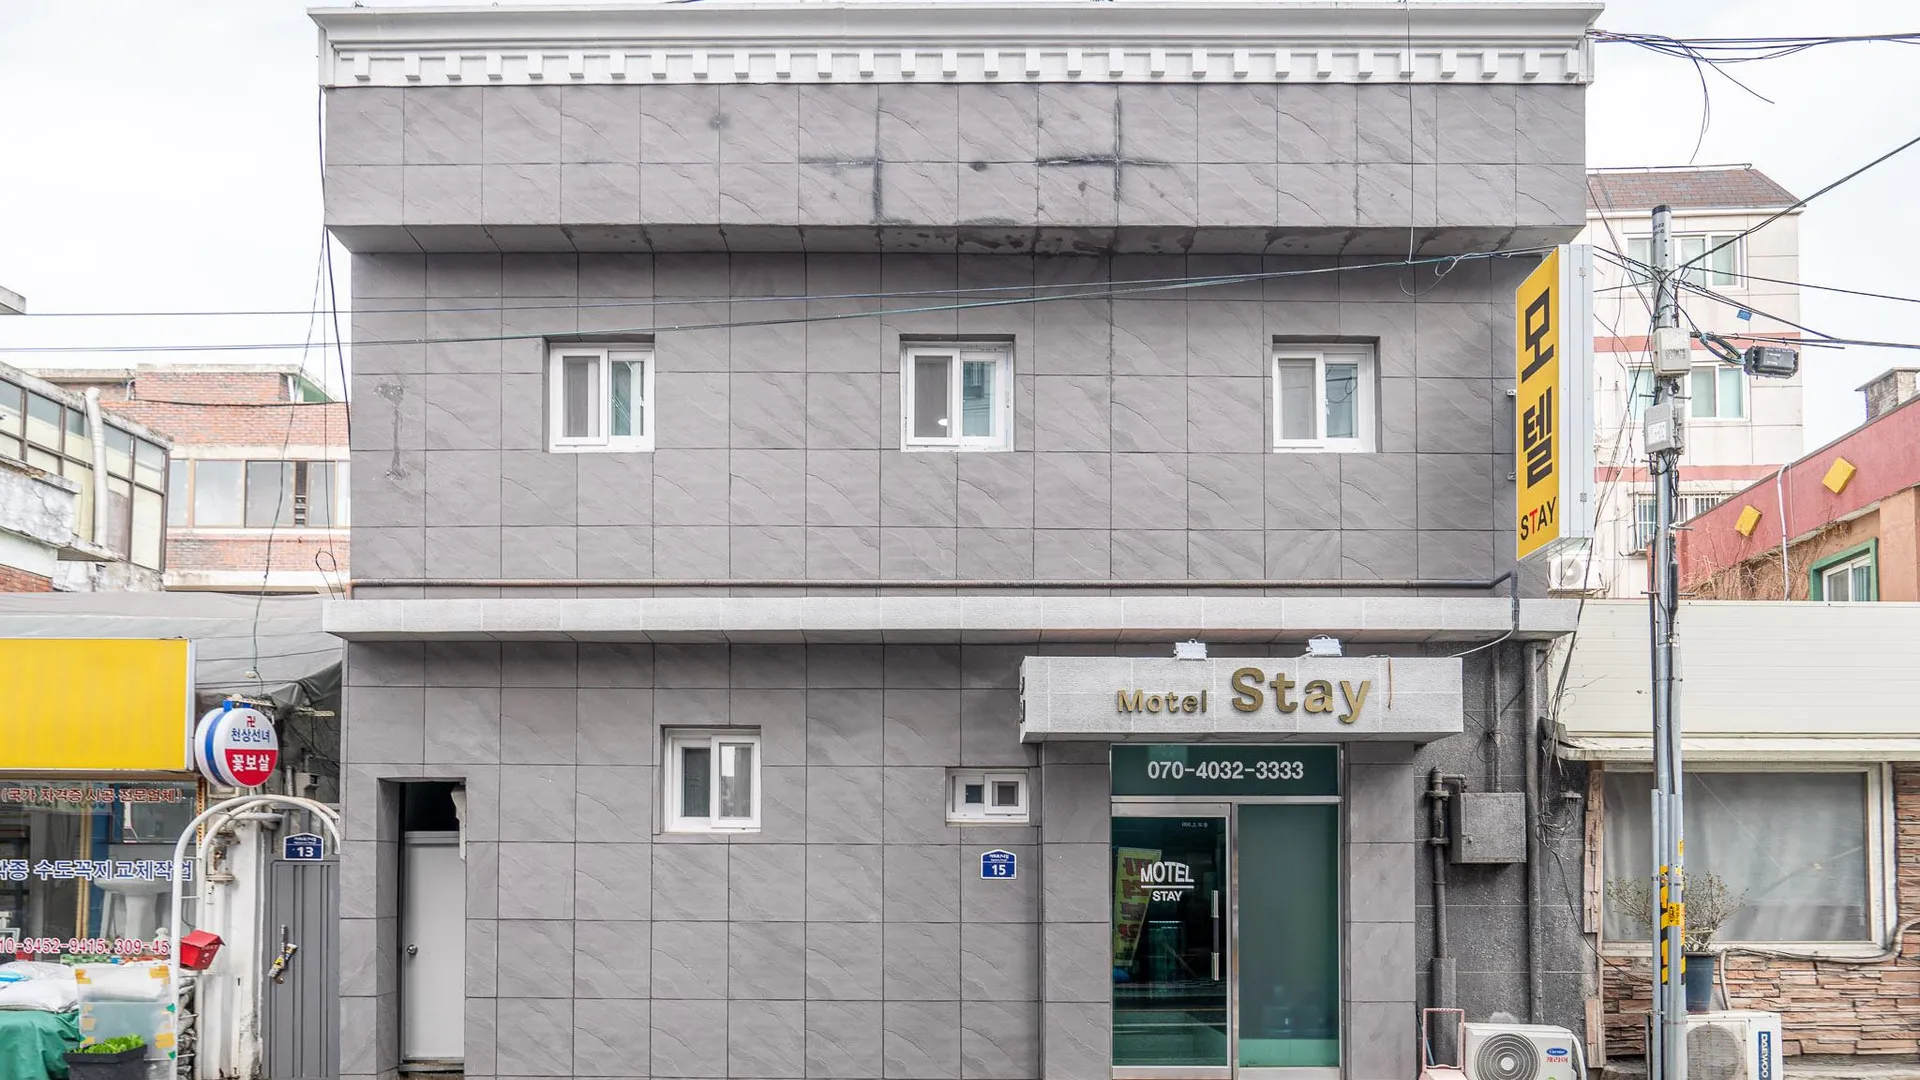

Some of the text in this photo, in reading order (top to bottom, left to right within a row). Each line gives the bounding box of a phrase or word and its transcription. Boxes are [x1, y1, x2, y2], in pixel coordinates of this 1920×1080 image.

[1521, 287, 1555, 489] 모텔
[1520, 497, 1557, 541] STAY
[1117, 667, 1371, 724] Motel Stay
[231, 728, 271, 743] 천상선녀
[232, 753, 271, 772] 꽃보살
[1147, 761, 1304, 780] 070-4032-3333
[40, 786, 83, 803] 자격증
[86, 787, 115, 803] 시공
[296, 846, 314, 858] 13
[991, 864, 1007, 876] 15
[1140, 861, 1195, 883] MOTEL
[1152, 890, 1183, 901] STAY
[1761, 1033, 1769, 1078] DAEWOO
